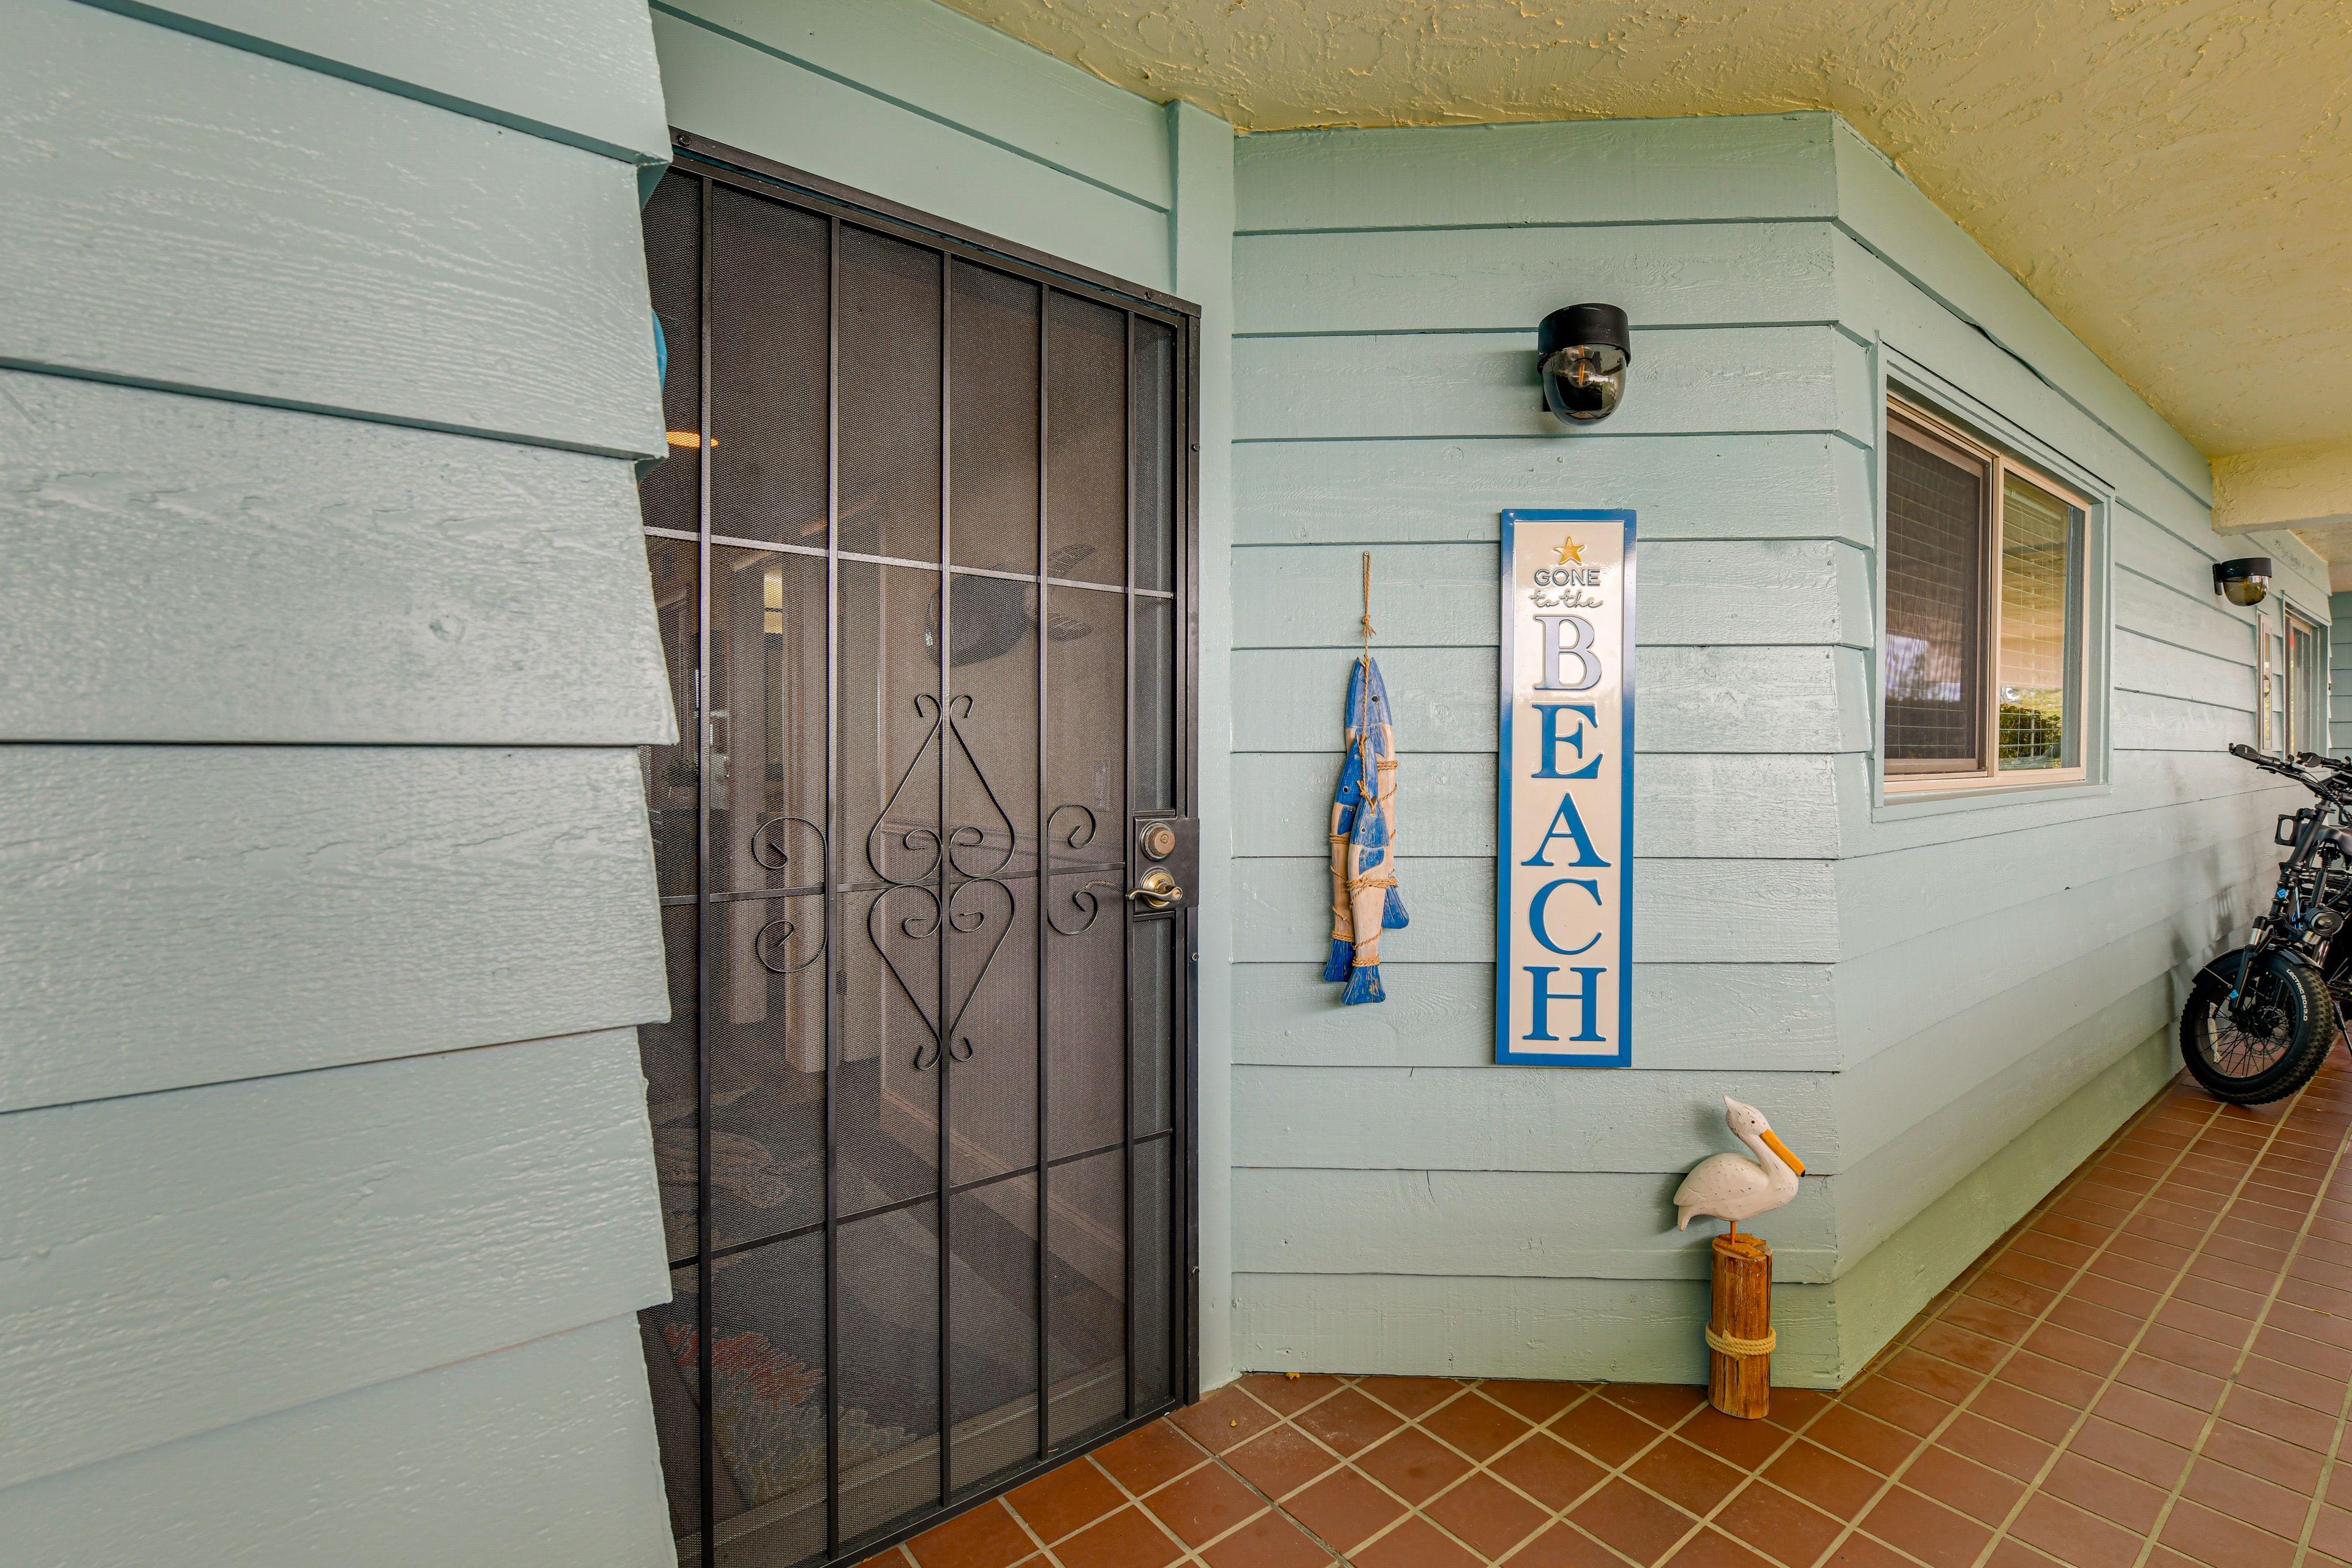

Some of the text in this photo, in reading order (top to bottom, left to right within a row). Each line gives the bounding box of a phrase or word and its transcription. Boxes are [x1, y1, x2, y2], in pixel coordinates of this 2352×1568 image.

[1534, 569, 1600, 586] GONE
[1529, 589, 1604, 608] to the
[1521, 615, 1612, 1042] BEACH
[2286, 968, 2305, 995] LECTRIC
